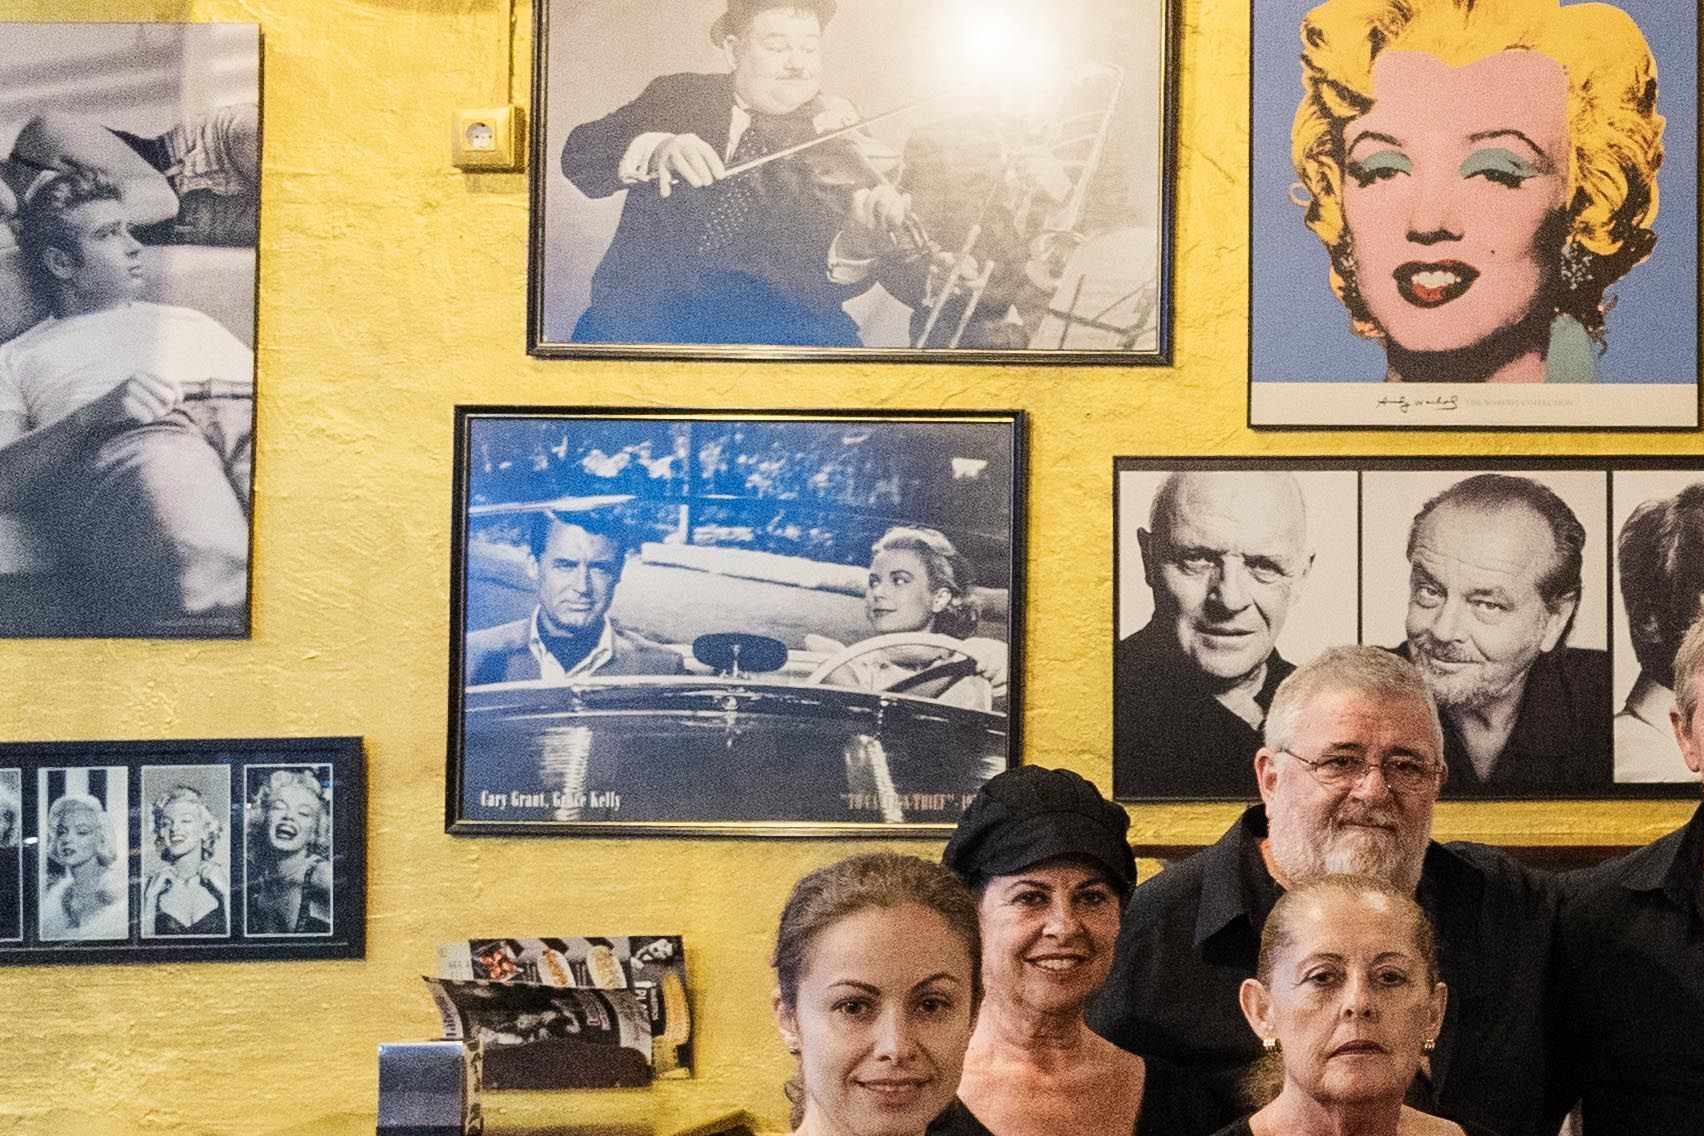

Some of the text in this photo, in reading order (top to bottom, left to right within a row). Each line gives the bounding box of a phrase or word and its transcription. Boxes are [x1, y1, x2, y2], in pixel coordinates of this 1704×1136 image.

[480, 789, 507, 810] Cary
[511, 789, 550, 809] Grant,
[590, 790, 621, 812] Kelly
